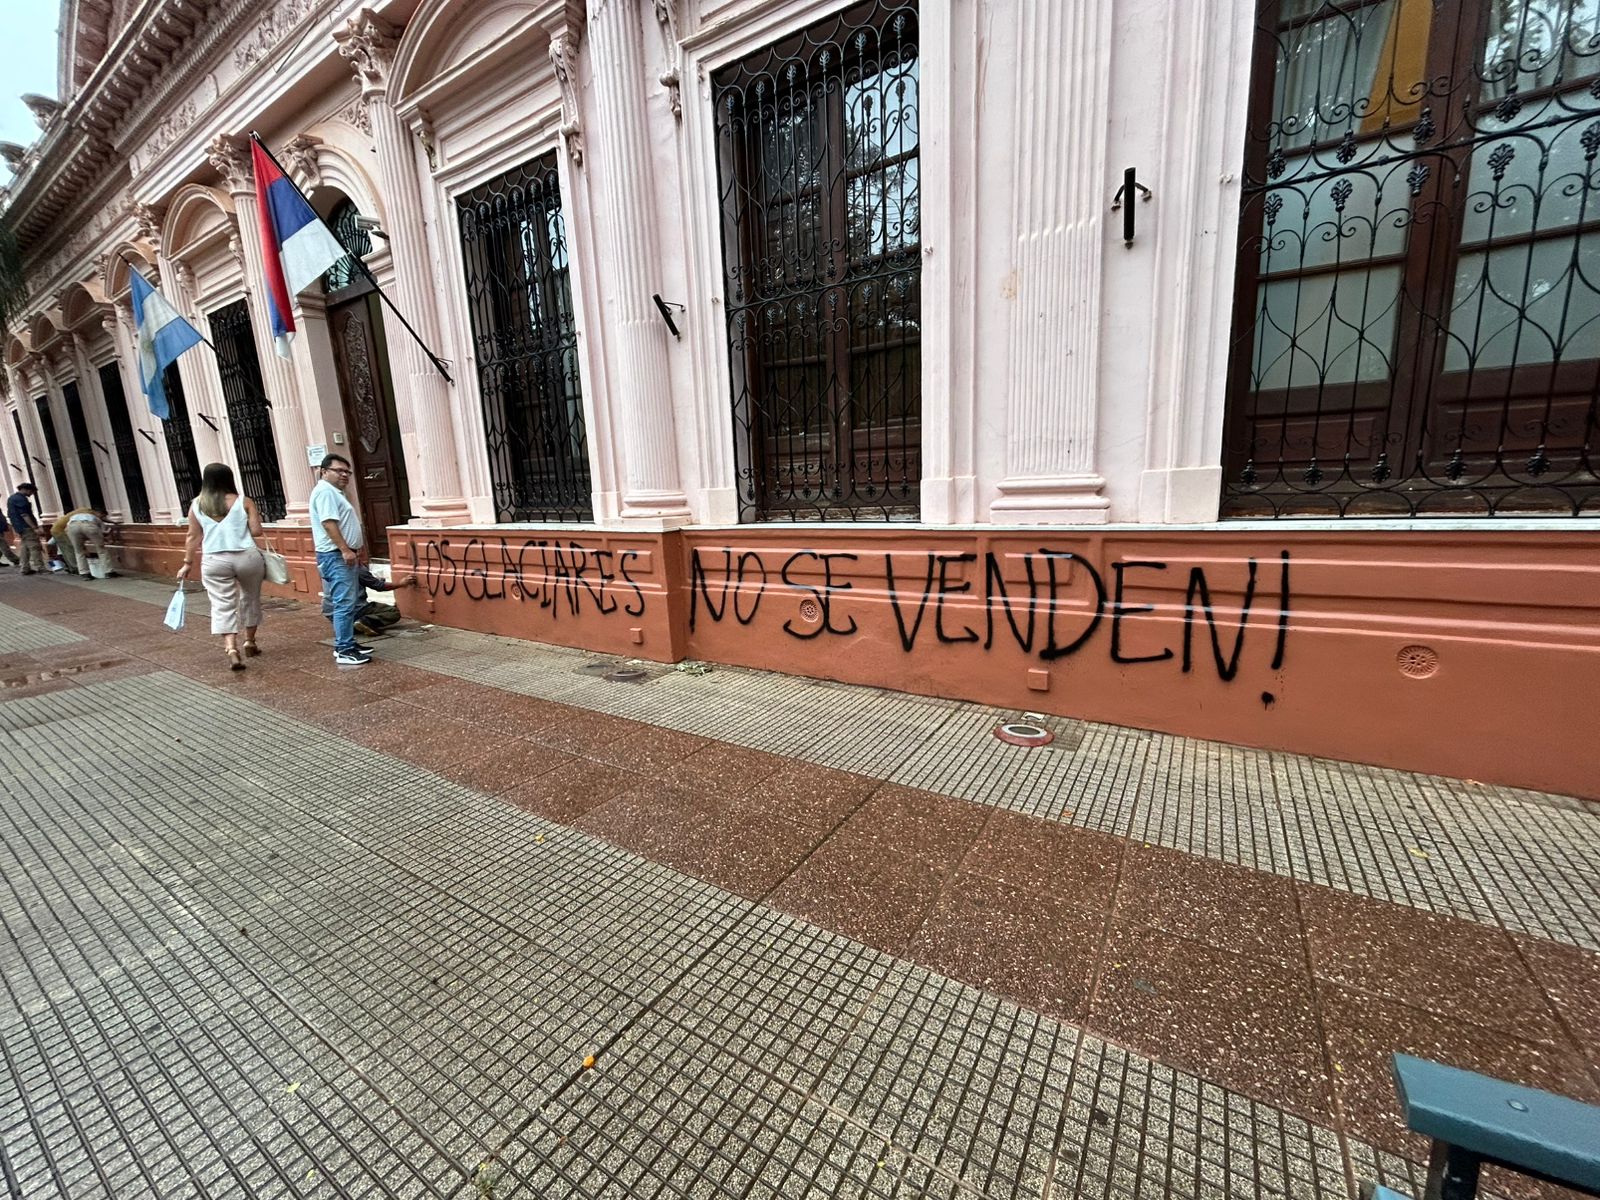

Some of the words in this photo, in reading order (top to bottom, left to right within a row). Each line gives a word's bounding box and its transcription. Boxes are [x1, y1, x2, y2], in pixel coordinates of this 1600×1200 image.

[463, 538, 645, 618] GLACIARES
[690, 547, 766, 634] NO
[782, 549, 858, 640] SE
[886, 548, 1289, 706] VENDEN!
